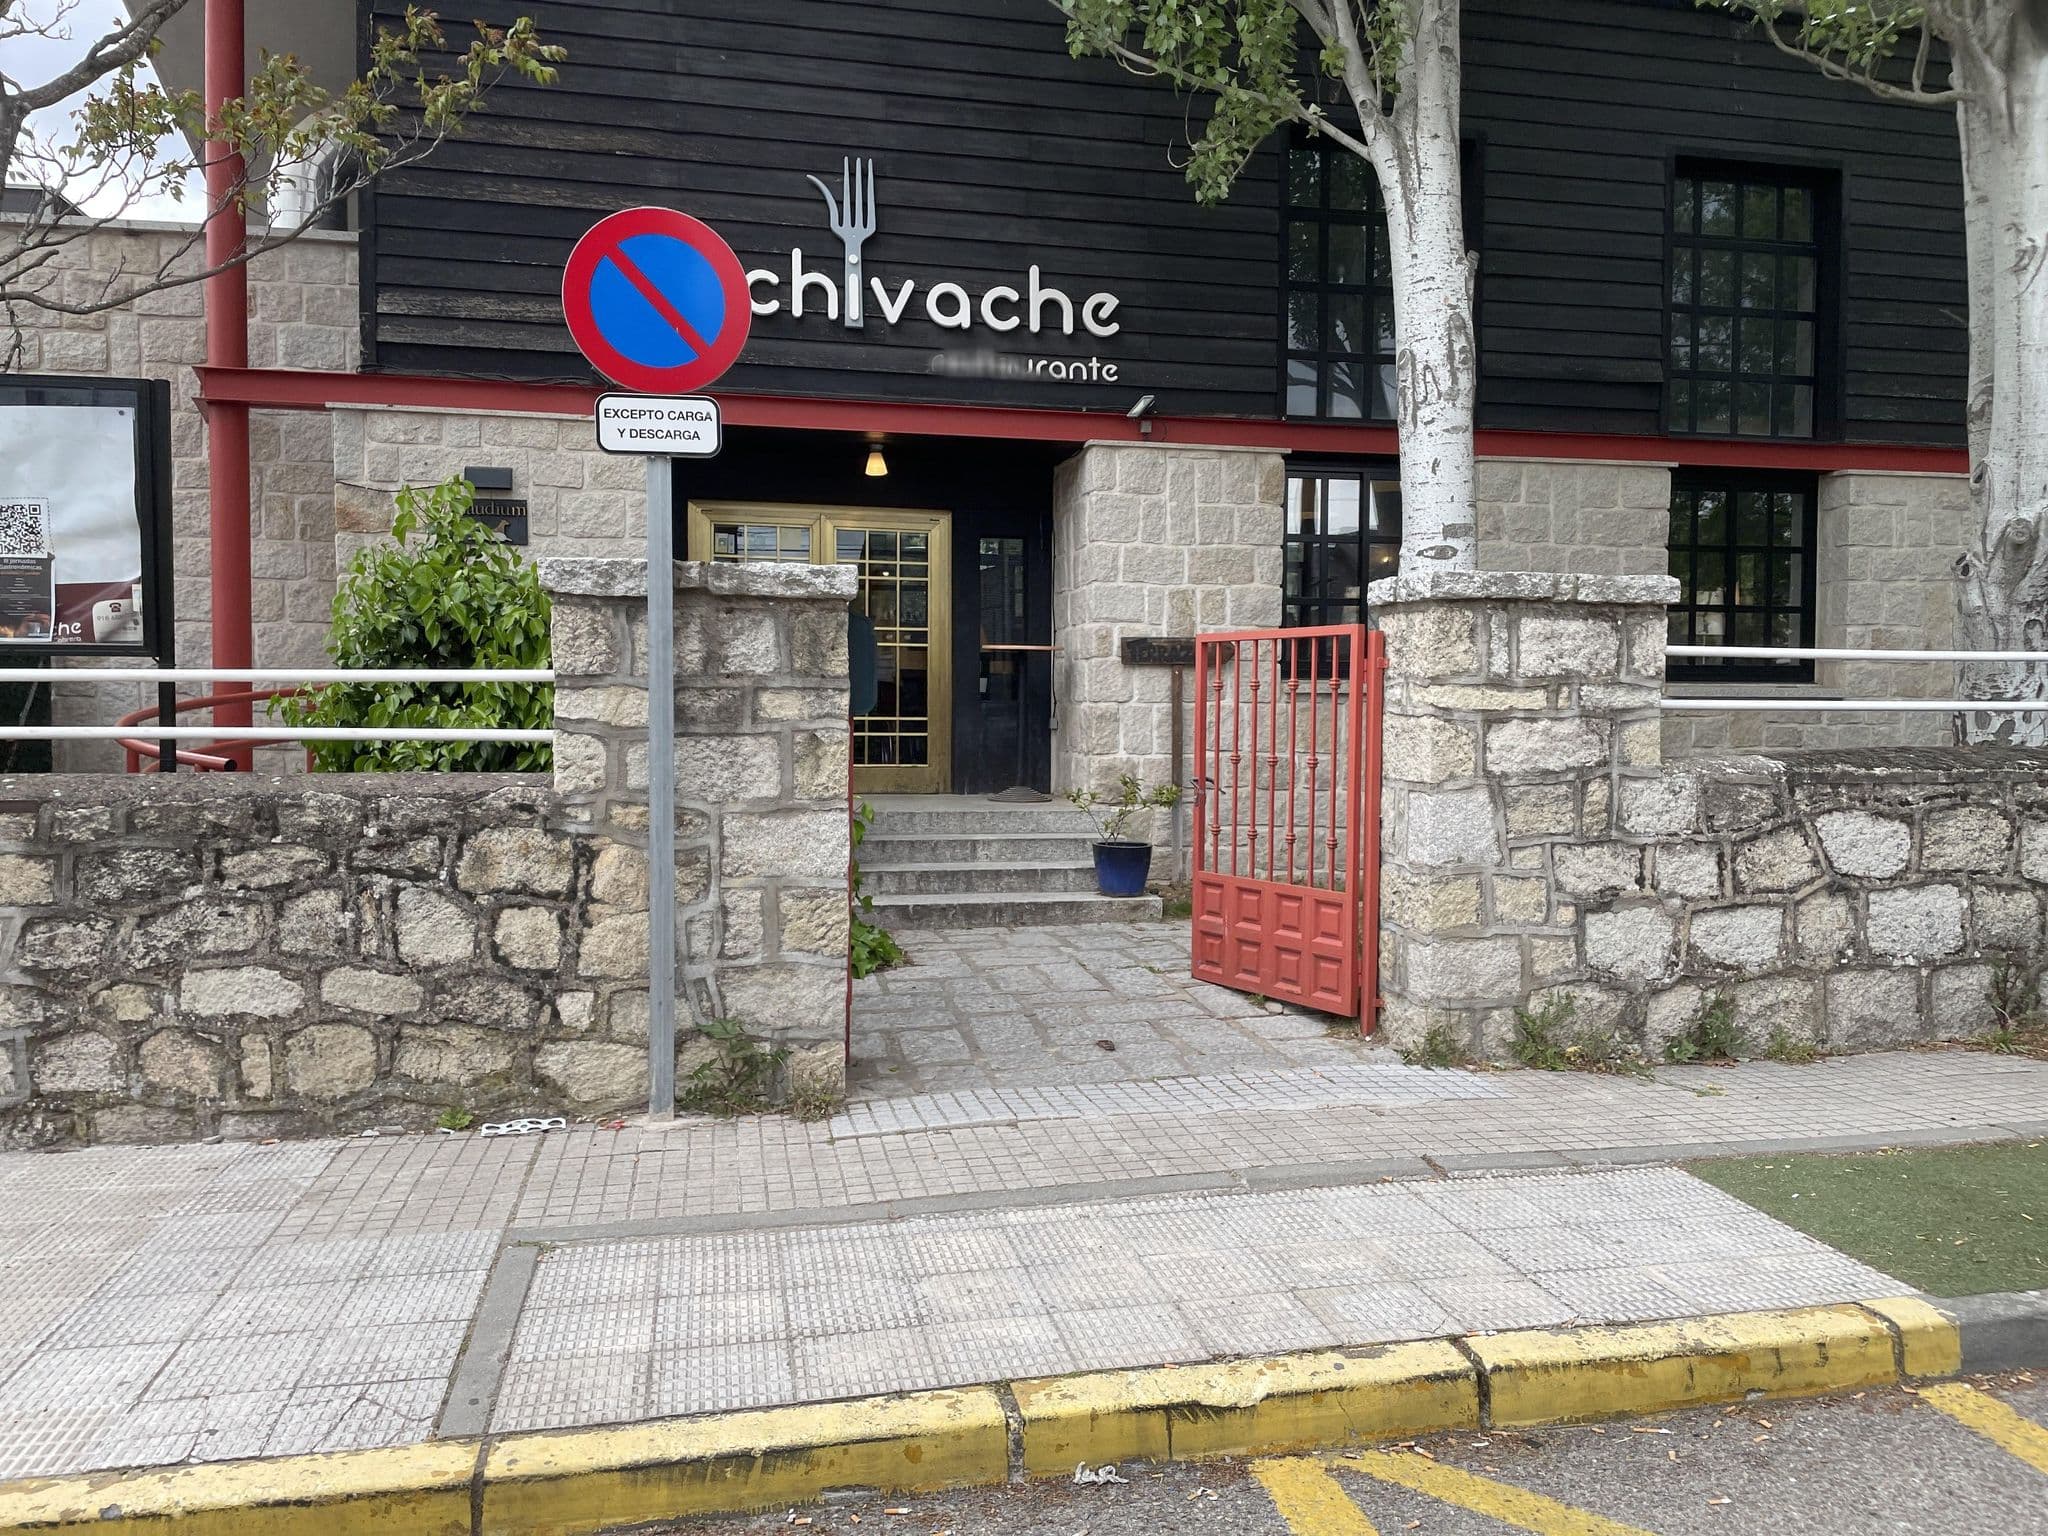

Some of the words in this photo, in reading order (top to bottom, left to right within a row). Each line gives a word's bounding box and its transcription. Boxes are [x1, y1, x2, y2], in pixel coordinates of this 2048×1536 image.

[746, 248, 1120, 336] chivache
[603, 408, 665, 420] EXCEPTO
[667, 410, 713, 422] CARGA
[617, 427, 626, 439] Y
[629, 428, 701, 440] DESCARGA
